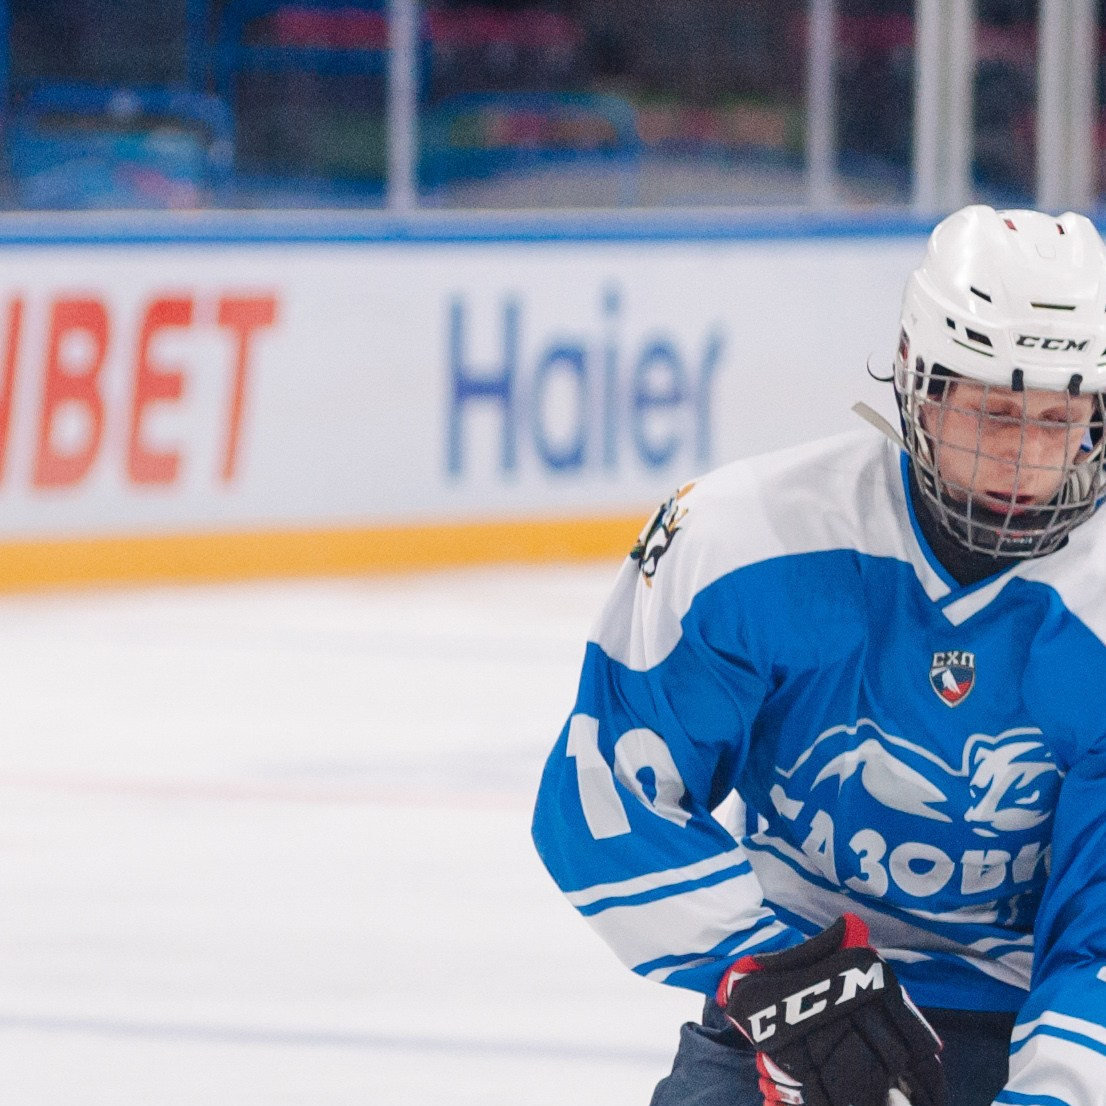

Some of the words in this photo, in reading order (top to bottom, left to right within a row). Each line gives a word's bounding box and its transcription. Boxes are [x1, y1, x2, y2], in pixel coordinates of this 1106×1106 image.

[446, 282, 728, 478] Haier
[1016, 334, 1091, 351] CCM
[932, 650, 975, 668] СХП
[566, 713, 692, 840] 10
[748, 962, 885, 1043] CCM
